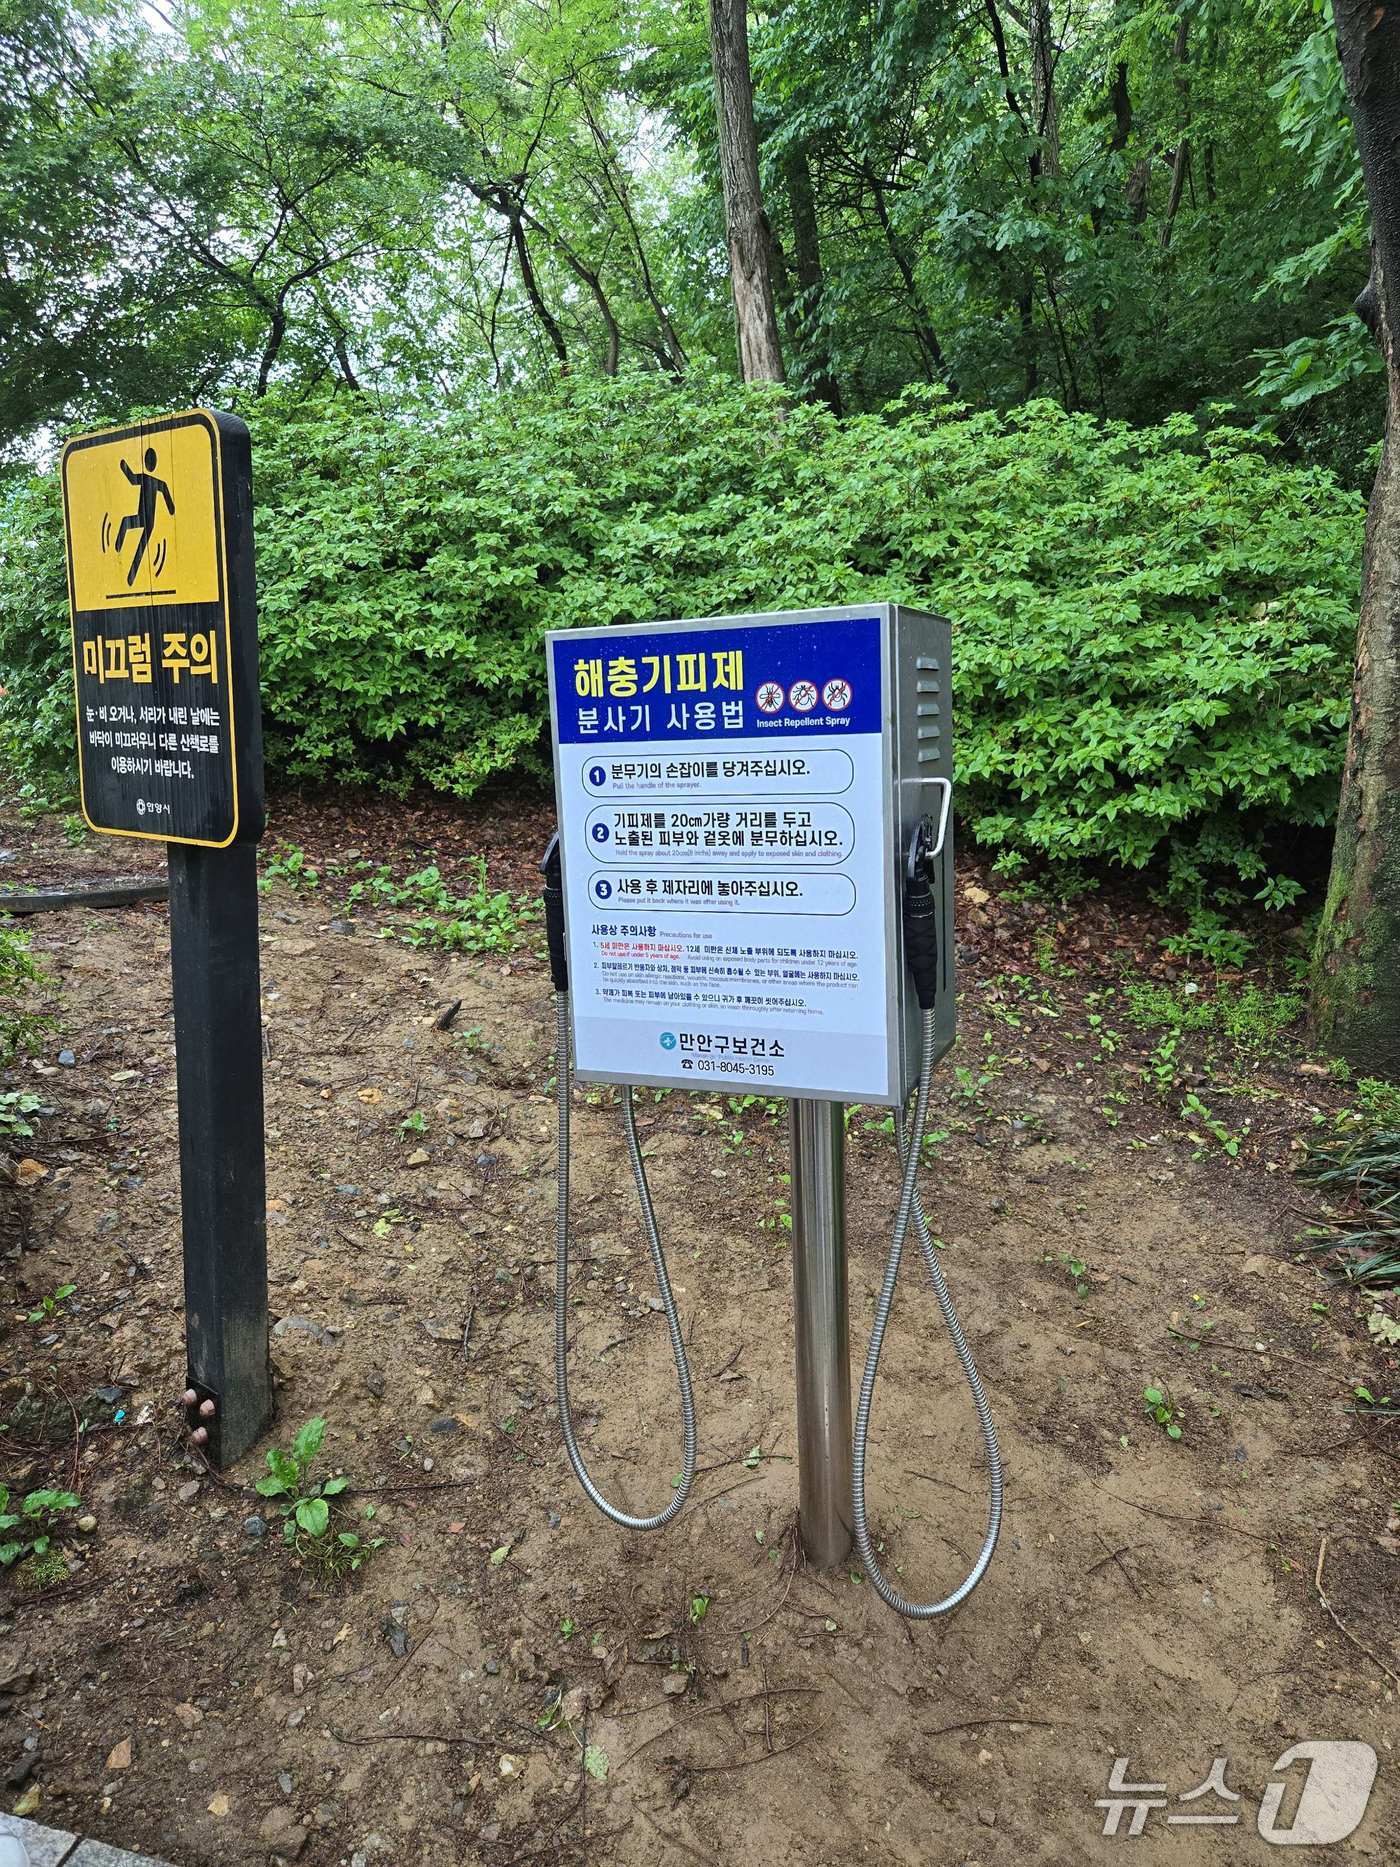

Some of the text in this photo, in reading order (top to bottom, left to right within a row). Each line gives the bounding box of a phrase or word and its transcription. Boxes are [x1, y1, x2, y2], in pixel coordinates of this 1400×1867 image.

[83, 630, 218, 684] 미끄럼 주의
[574, 650, 744, 698] 해충기피제
[109, 705, 137, 724] 오거나,
[139, 706, 166, 724] 서리가
[168, 706, 188, 725] 내린
[190, 707, 220, 726] 날에는
[578, 700, 743, 734] 분사기 사용법
[757, 716, 851, 728] Insect Repellent Spray
[90, 730, 219, 754] 바닥이 미끄러우니 다른 산책로를
[111, 756, 194, 779] 이용하시기 바랍니다.
[611, 759, 810, 780] 분무기의 손잡이를 당겨주십시오.
[613, 782, 624, 790] Pull
[625, 782, 635, 790] the
[636, 782, 656, 790] handle
[657, 781, 664, 789] of
[665, 781, 675, 789] the
[614, 813, 666, 829] 기피제를
[735, 811, 777, 828] 거리를
[782, 811, 812, 828] 두고
[614, 830, 843, 847] 노출된 피부와 겉옷에 분무하십시오.
[617, 879, 804, 897] 사용 후 제자리에 놓아주십시오.
[592, 924, 657, 937] 사용상 주의사항
[679, 1033, 785, 1057] 만안구보건소
[697, 1060, 775, 1077] 031-8045-3195
